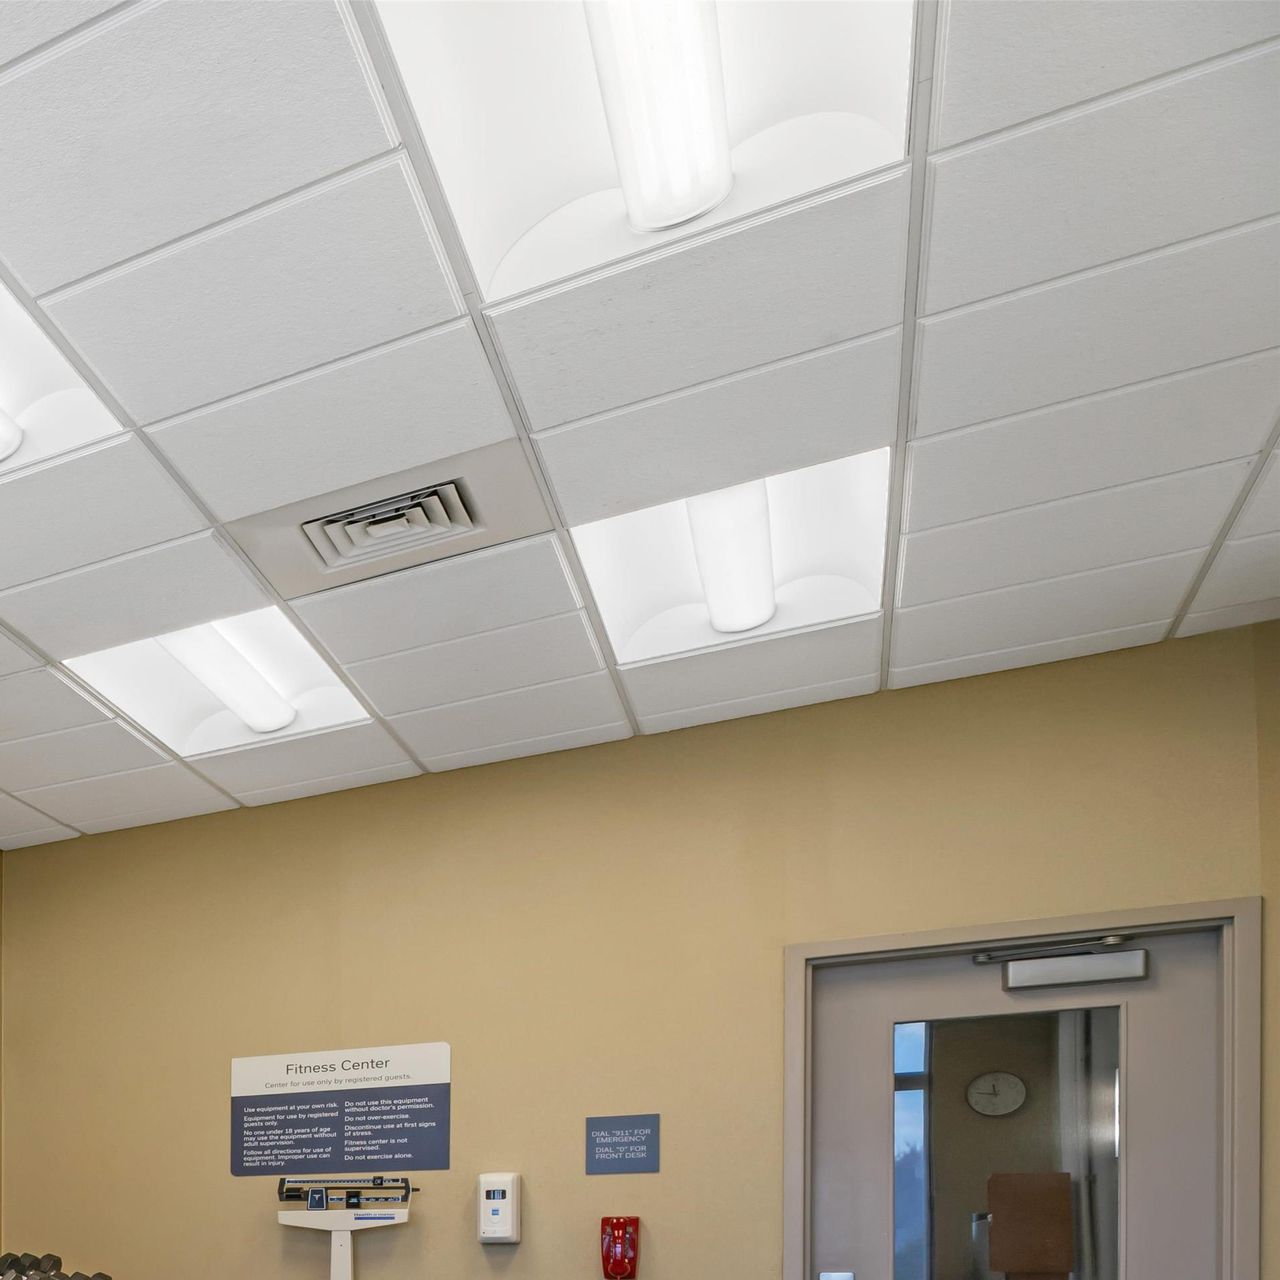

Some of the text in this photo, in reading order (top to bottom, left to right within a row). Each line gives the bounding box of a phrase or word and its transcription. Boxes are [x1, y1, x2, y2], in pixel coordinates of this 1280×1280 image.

[286, 1059, 390, 1075] Fitness Center
[345, 1074, 382, 1083] registered
